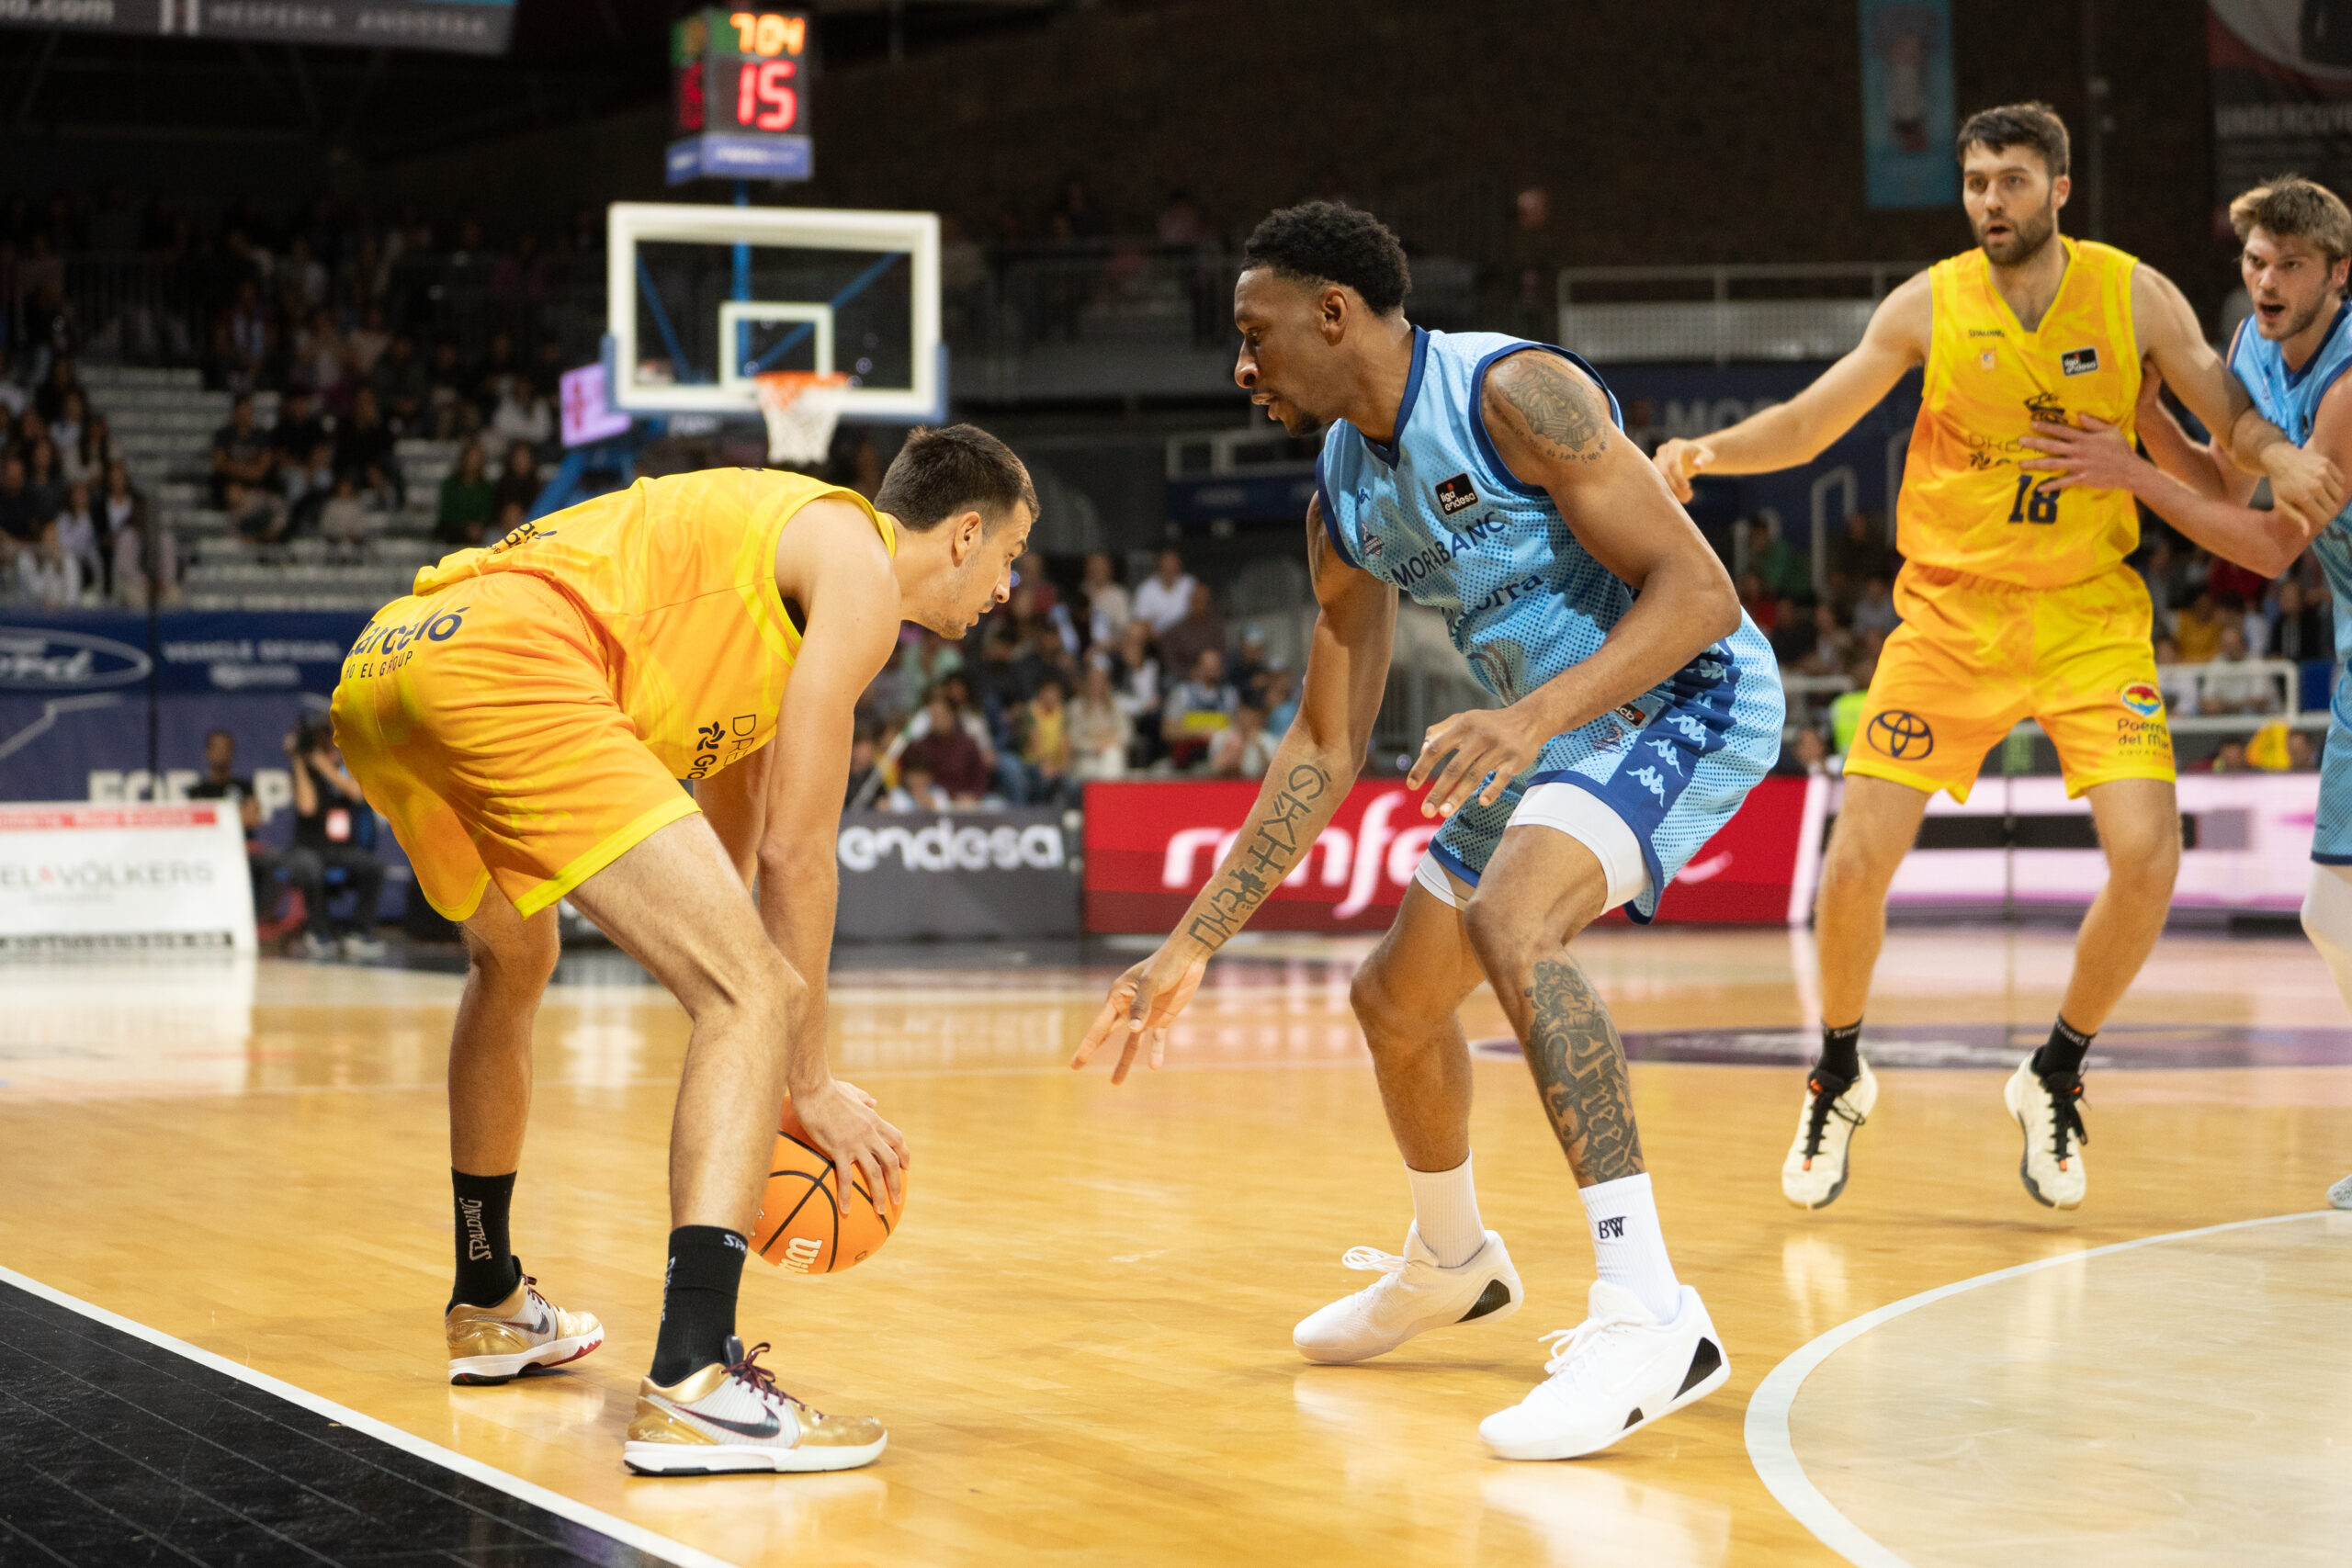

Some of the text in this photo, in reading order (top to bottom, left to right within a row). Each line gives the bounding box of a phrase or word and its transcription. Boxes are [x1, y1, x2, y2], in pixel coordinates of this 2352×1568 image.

[737, 60, 797, 130] 15
[1440, 490, 1456, 503] liga
[1444, 492, 1476, 512] endesa
[2008, 474, 2061, 524] 18
[1391, 511, 1505, 588] MORABANC
[379, 650, 413, 677] GROUP
[837, 817, 1065, 872] endesa
[459, 1197, 492, 1261] SPALDING
[1599, 1215, 1627, 1240] BW
